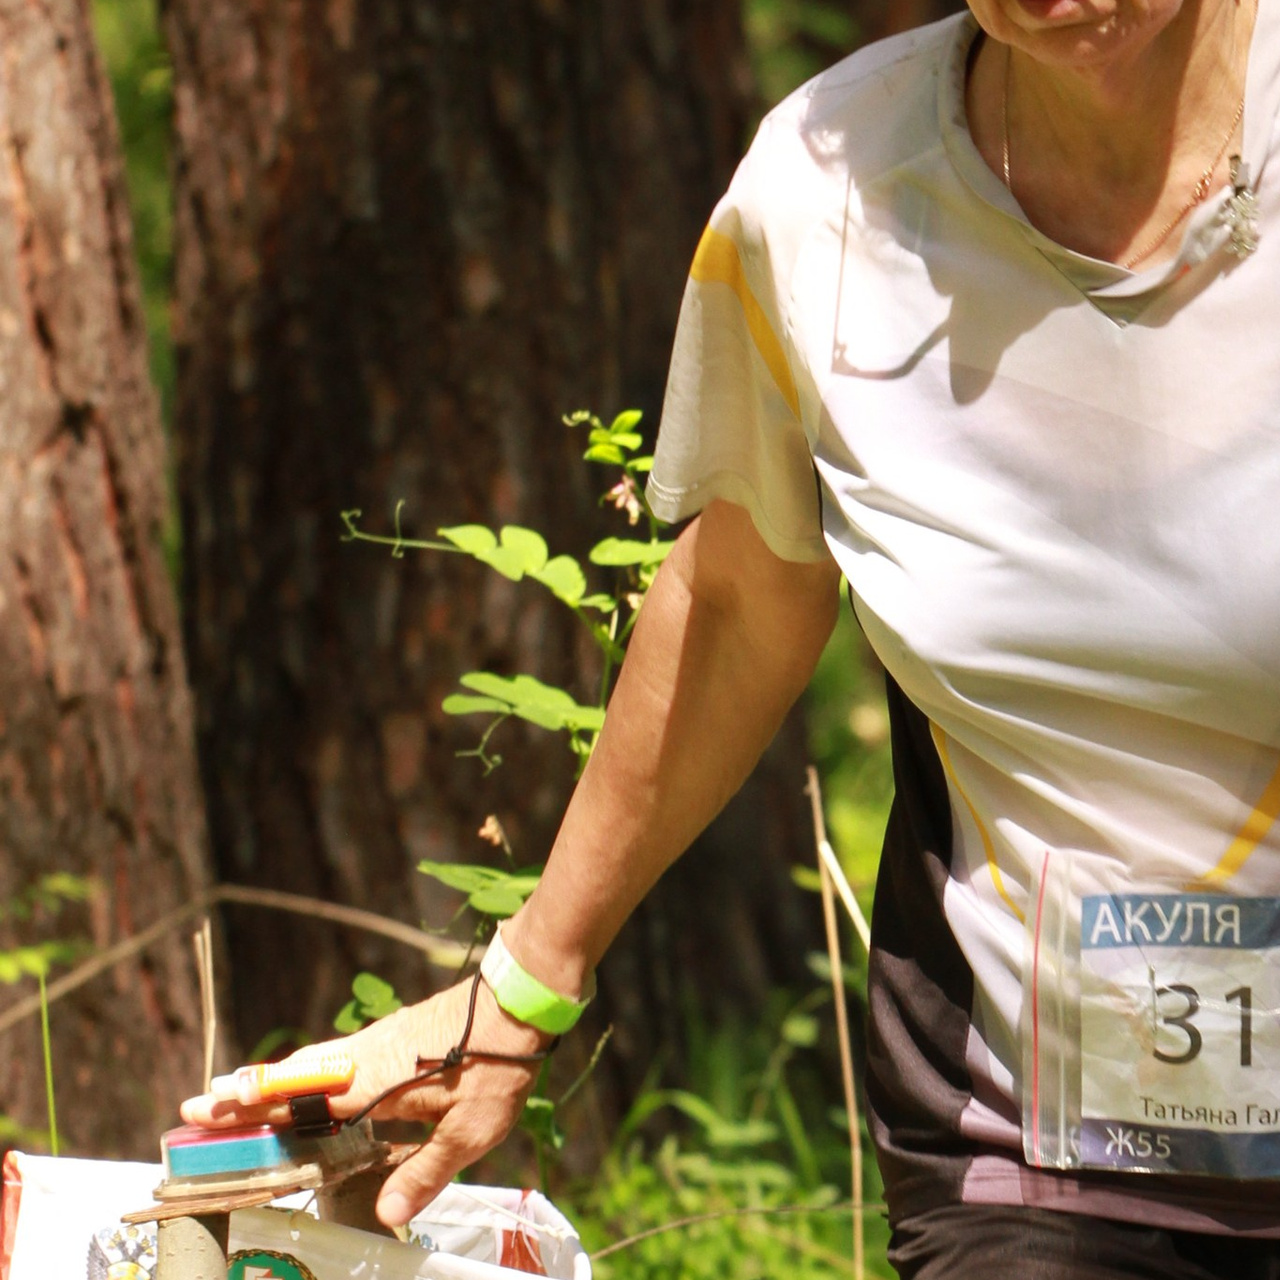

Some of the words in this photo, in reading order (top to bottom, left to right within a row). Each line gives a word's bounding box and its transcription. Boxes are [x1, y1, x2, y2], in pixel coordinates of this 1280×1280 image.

[1090, 901, 1241, 945] АКУЛЯ
[1139, 1095, 1238, 1126] Татьяна
[1105, 1126, 1171, 1160] Ж55
